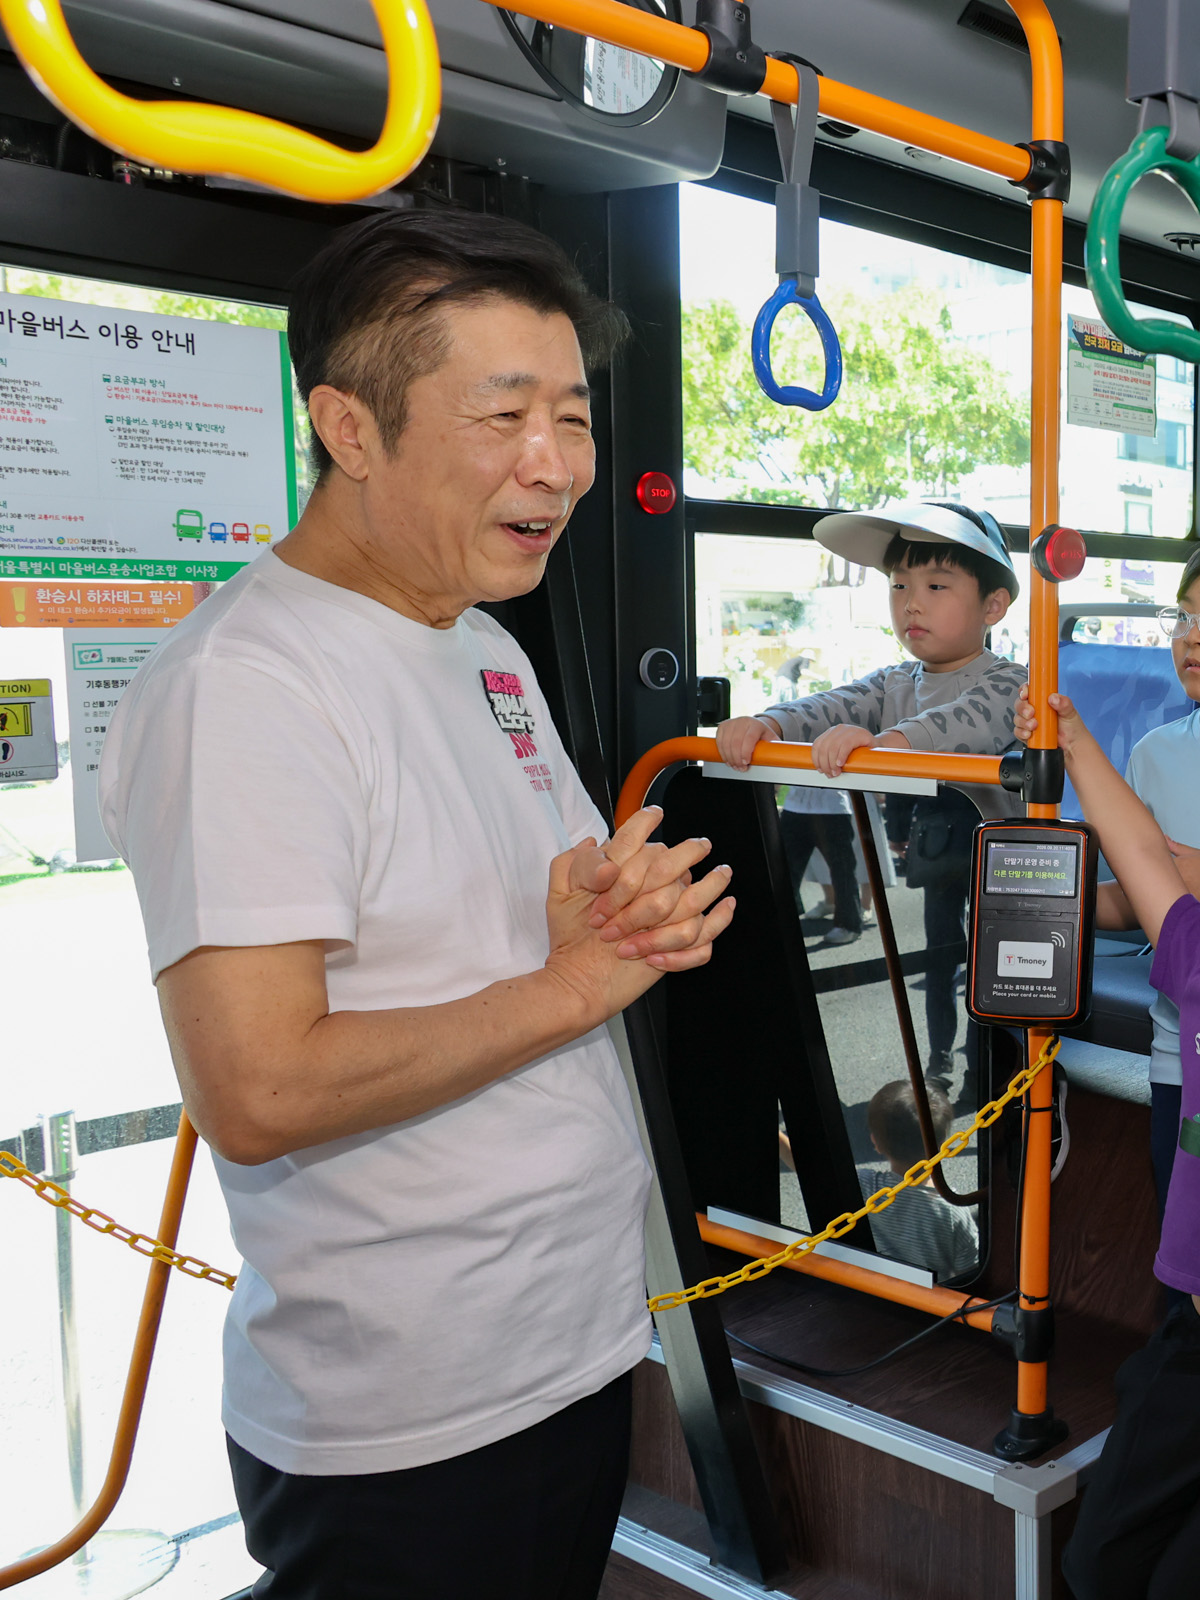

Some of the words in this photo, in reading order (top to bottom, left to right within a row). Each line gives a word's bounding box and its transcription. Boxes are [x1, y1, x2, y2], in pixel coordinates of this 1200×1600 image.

[98, 322, 143, 349] 이용
[151, 329, 196, 355] 안내
[1084, 334, 1097, 347] 전국
[1111, 340, 1123, 353] 요금
[114, 375, 147, 386] 요금부과
[149, 379, 166, 389] 방식
[116, 416, 149, 426] 마을버스
[151, 418, 183, 429] 무임승차
[195, 422, 226, 434] 할인대상
[651, 488, 671, 498] STOP
[59, 562, 177, 577] 마을버스운송사업조합
[185, 565, 219, 579] 이사장
[36, 588, 81, 605] 환승시
[87, 589, 145, 605] 하차태그
[149, 590, 182, 606] 필수!
[74, 607, 96, 615] 환승시
[86, 679, 131, 689] 기후동행카
[1004, 858, 1023, 866] 단말기
[1024, 858, 1037, 866] 운영
[1039, 859, 1052, 867] 준비
[1053, 859, 1060, 867] 중
[993, 870, 1007, 878] 다른
[1008, 871, 1033, 879] 단말기를
[1017, 956, 1047, 966] Tmoney
